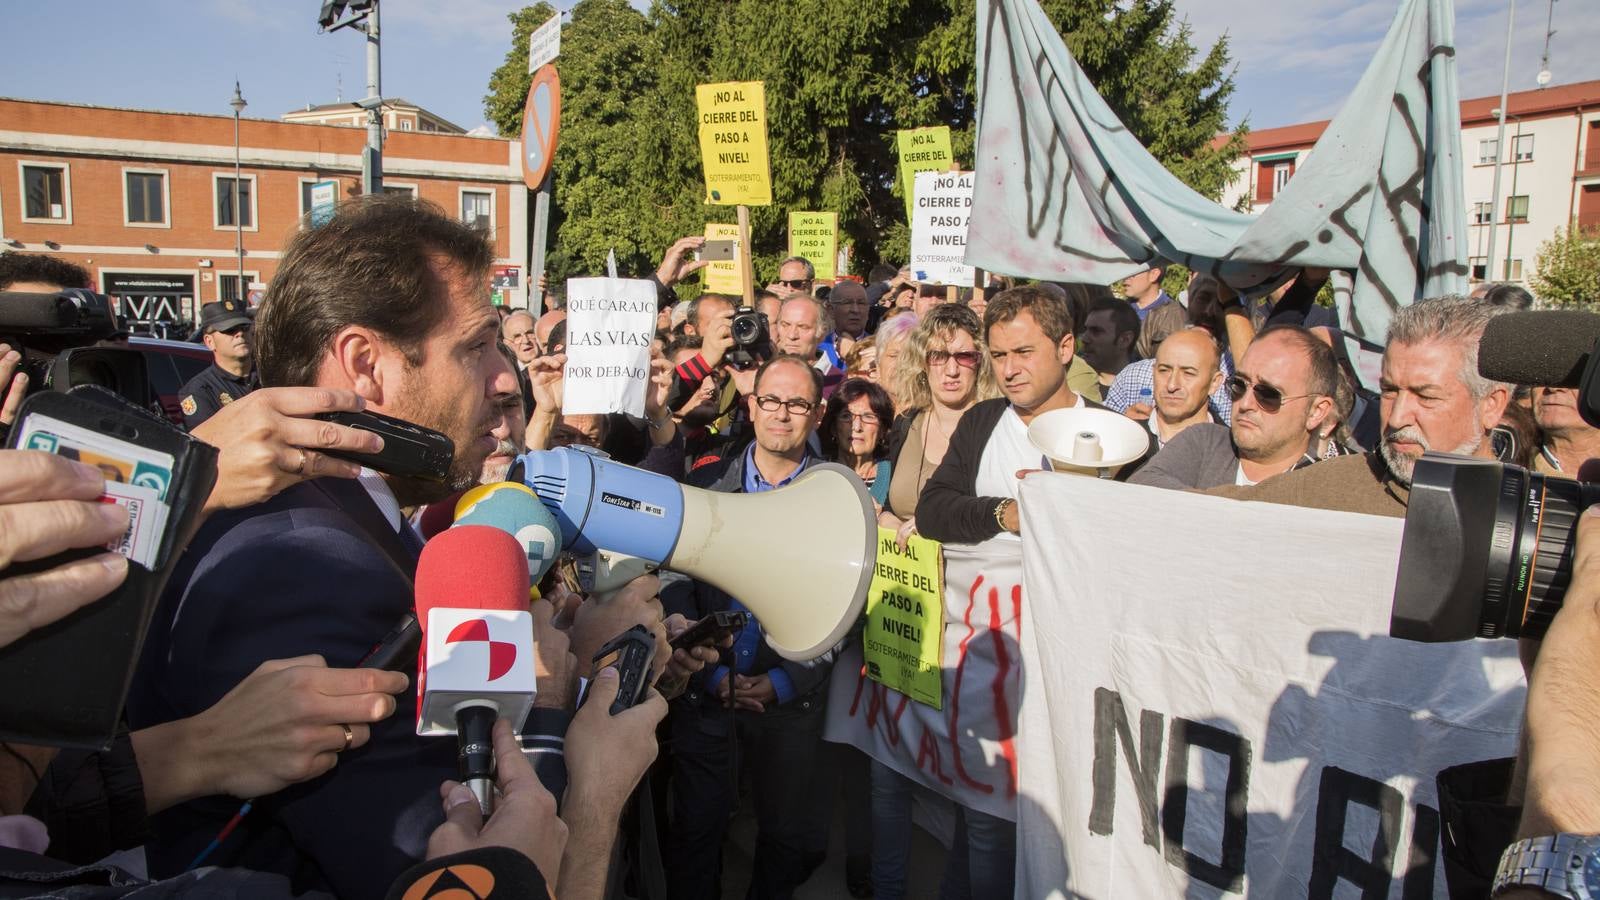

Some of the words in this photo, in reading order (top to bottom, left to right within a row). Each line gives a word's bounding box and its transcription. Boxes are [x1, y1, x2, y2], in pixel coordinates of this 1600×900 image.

[714, 91, 731, 106] ¡NO
[733, 90, 745, 102] AL
[703, 112, 737, 124] CIERRE
[739, 110, 758, 122] DEL
[715, 132, 740, 144] PASO
[742, 132, 749, 143] A
[911, 135, 925, 147] ¡NO
[926, 134, 935, 144] AL
[719, 152, 750, 164] NIVEL!
[904, 152, 931, 163] CIERRE
[932, 150, 947, 160] DEL
[934, 178, 954, 191] ¡NO
[957, 178, 972, 188] AL
[919, 197, 961, 208] CIERRE
[801, 218, 814, 226] ¡NO
[930, 216, 961, 227] PASO
[916, 254, 965, 263] SOTERRAMIE
[502, 276, 510, 287] 2
[570, 296, 596, 312] QUÉ
[598, 298, 655, 314] CARAJO
[569, 331, 602, 346] LAS
[607, 331, 650, 348] VIAS
[568, 366, 593, 378] POR
[597, 366, 646, 380] DEBAJO
[881, 538, 901, 555] ¡NO
[905, 545, 919, 561] AL
[874, 562, 909, 586] IERRE
[912, 574, 935, 594] DEL
[1517, 566, 1528, 592] FUJINON
[881, 590, 912, 612] PASO
[915, 601, 923, 617] A
[882, 617, 921, 643] NIVEL!
[868, 640, 935, 675] SOTERRAMIENTO,
[1088, 686, 1252, 895] NO
